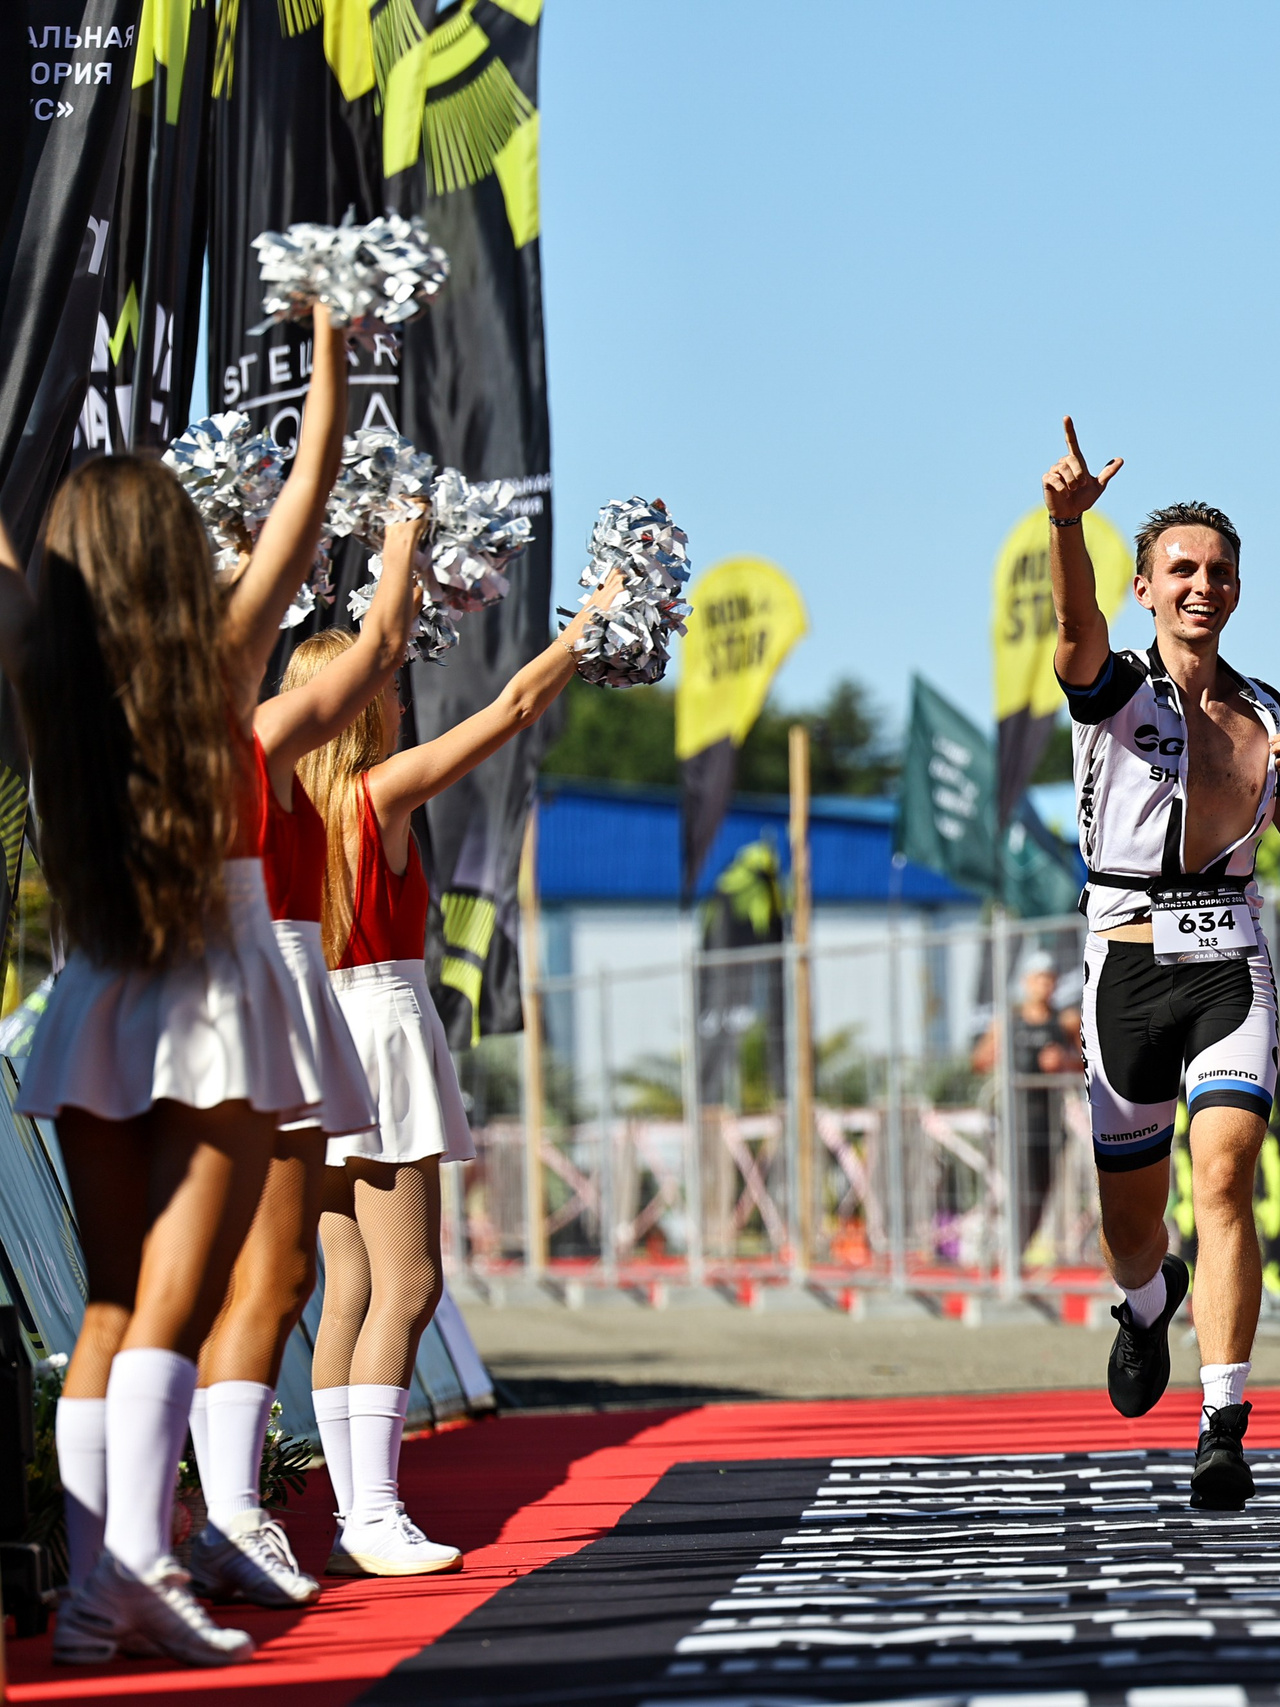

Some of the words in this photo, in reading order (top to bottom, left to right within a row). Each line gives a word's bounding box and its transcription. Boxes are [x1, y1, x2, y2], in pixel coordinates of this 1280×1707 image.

[30, 61, 112, 85] ОРИЯ
[30, 97, 75, 121] С»
[1149, 765, 1179, 784] SH
[1155, 900, 1197, 909] IRONSTAR
[1199, 897, 1230, 906] СИРИУС
[1178, 909, 1236, 934] 634
[1198, 937, 1218, 947] 113
[1197, 1069, 1258, 1082] SHIMANO
[1100, 1123, 1159, 1142] SHIMANO
